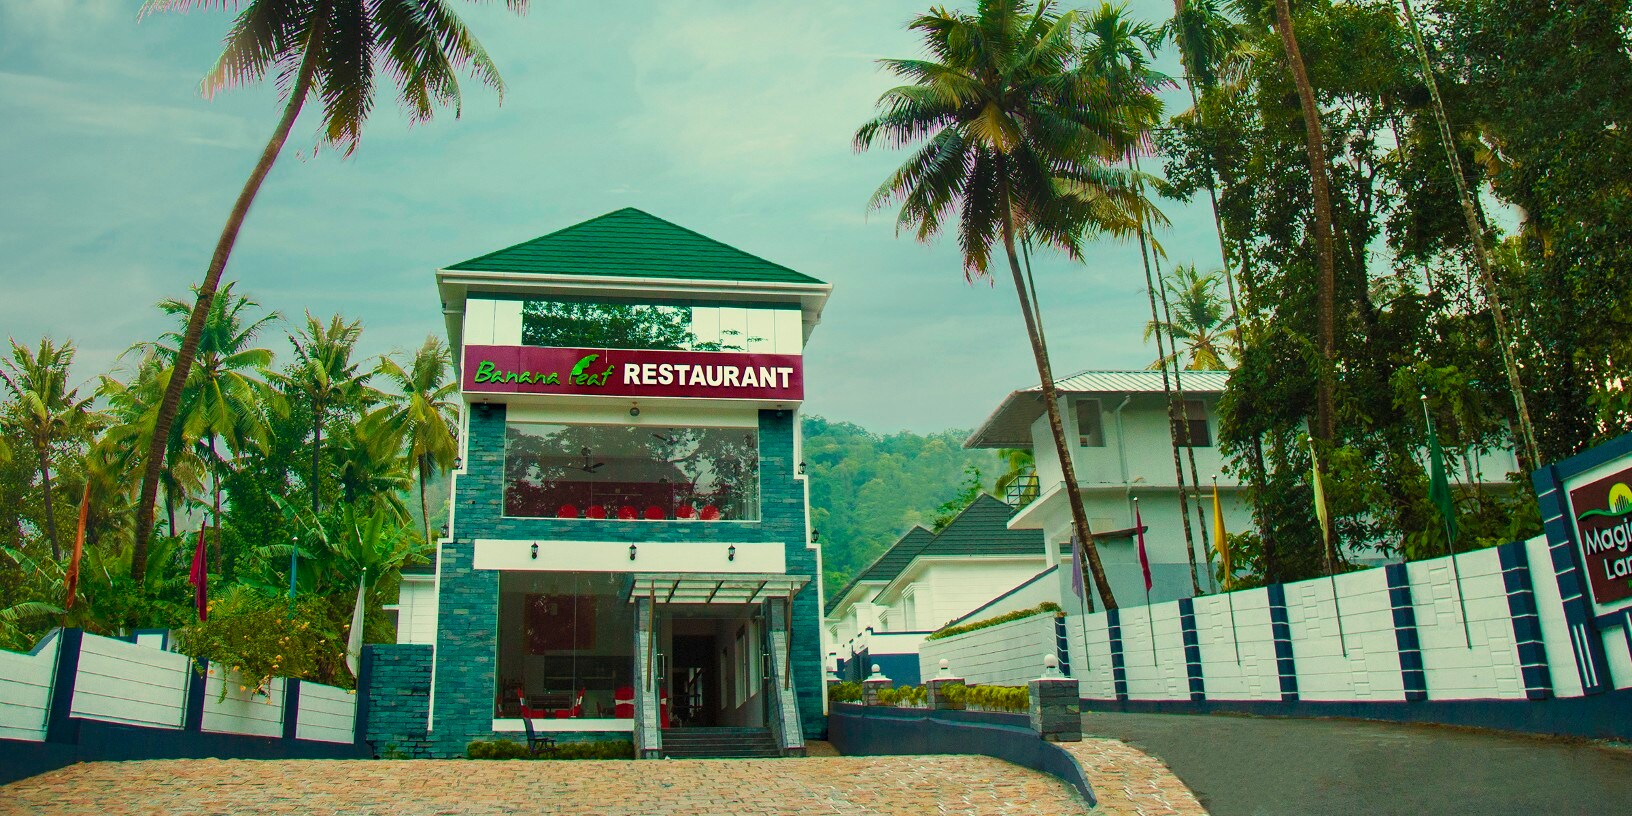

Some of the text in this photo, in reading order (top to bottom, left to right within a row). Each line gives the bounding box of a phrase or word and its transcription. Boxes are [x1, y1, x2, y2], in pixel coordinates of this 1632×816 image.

[474, 360, 561, 384] Banana
[623, 363, 794, 388] RESTAURANT
[1584, 517, 1632, 556] Magi
